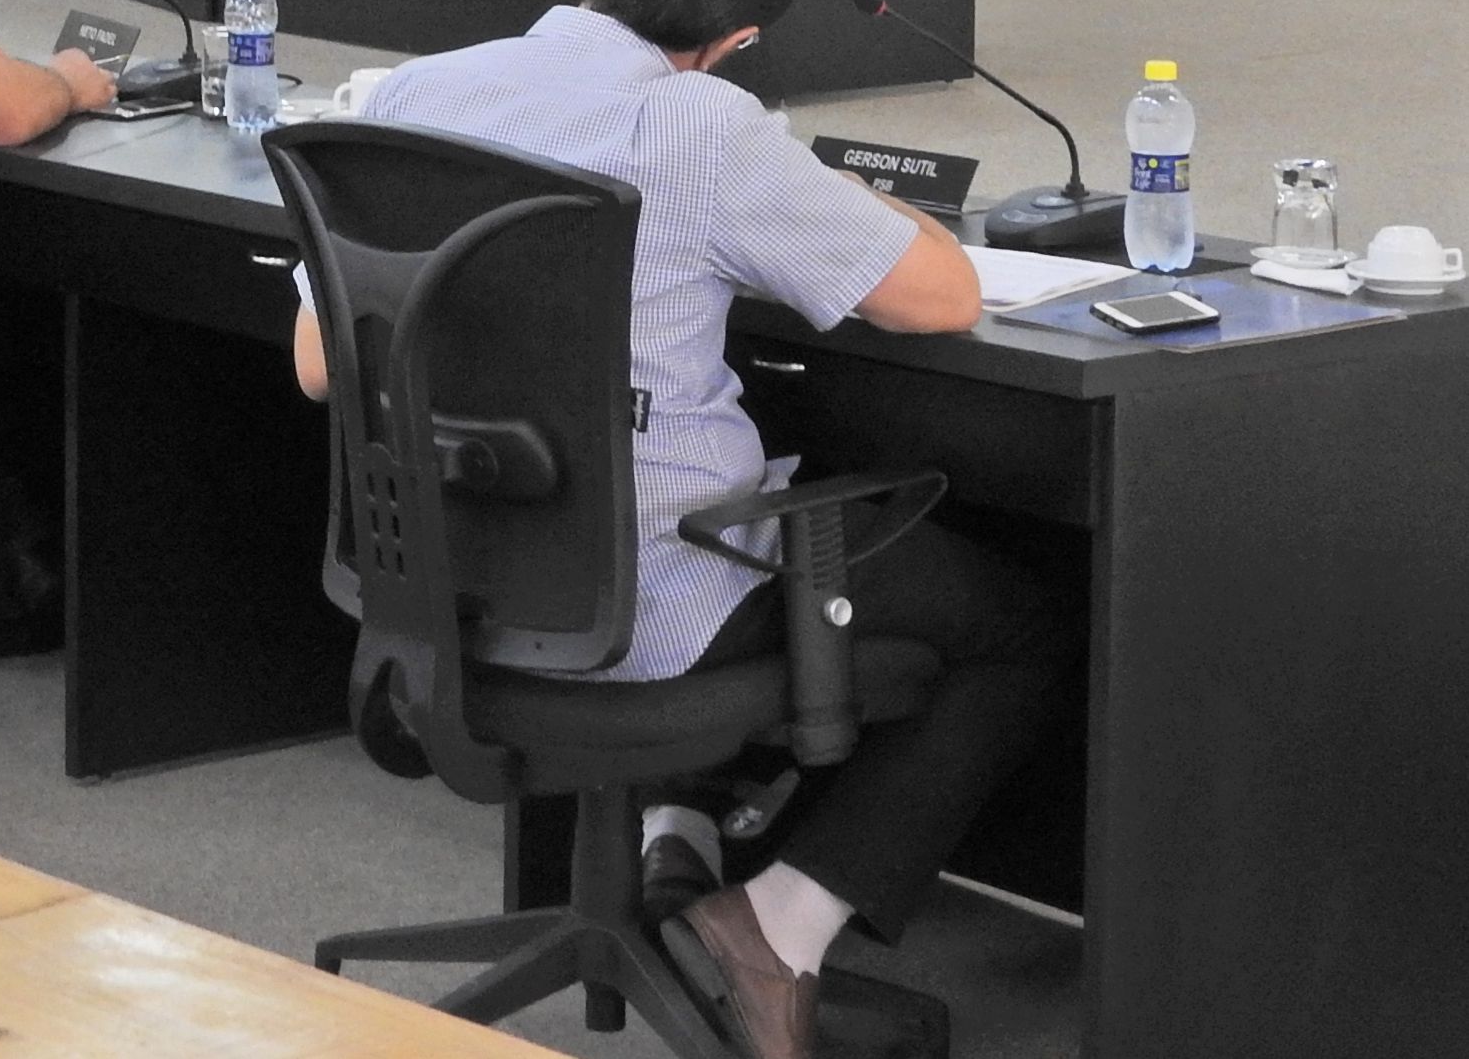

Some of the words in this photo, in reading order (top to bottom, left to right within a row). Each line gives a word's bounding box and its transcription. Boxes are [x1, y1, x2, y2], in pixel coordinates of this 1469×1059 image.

[843, 148, 901, 172] GERSON
[900, 156, 938, 178] SUTIL
[872, 177, 895, 193] PSB
